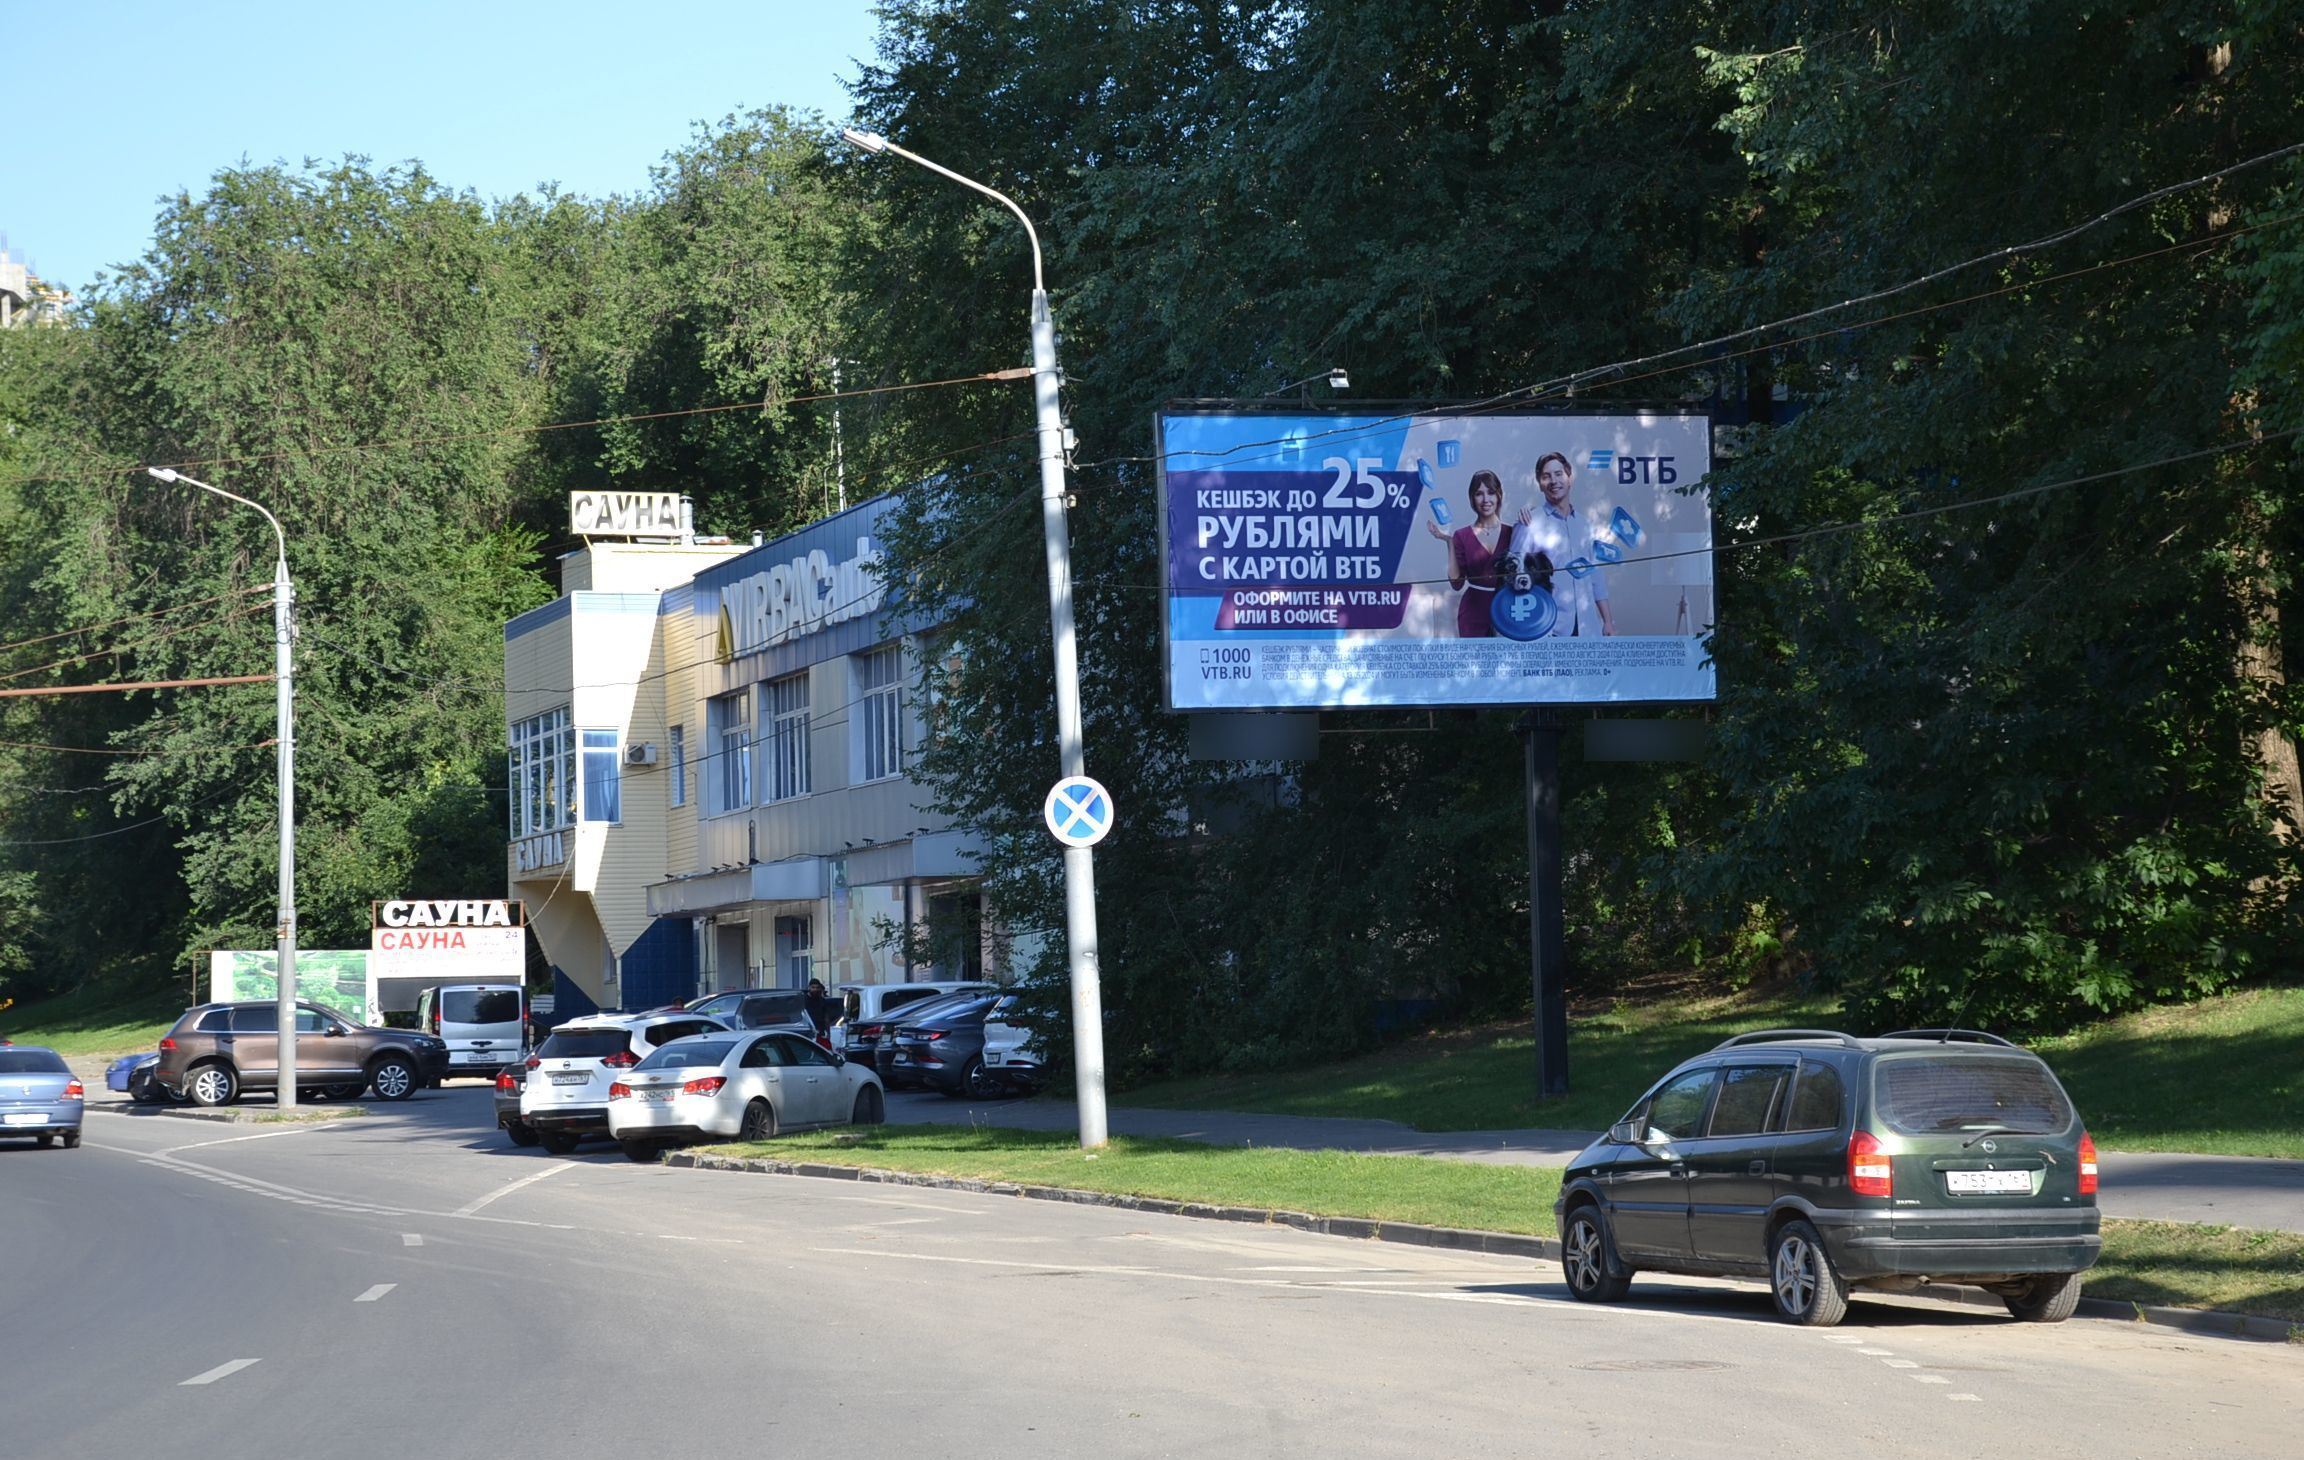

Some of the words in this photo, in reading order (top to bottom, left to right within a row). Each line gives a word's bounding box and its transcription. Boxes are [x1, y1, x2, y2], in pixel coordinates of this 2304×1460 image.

[1617, 456, 1677, 485] ВТБ
[1196, 489, 1282, 509] КЕШБЭК
[1286, 489, 1317, 512] ДО
[1322, 456, 1411, 509] 25%
[574, 494, 677, 530] САУНА
[1197, 515, 1380, 549] РУБЛЯМИ
[1198, 556, 1216, 580] С
[1223, 550, 1328, 580] КАРТОЙ
[1335, 555, 1382, 580] ВТБ
[1233, 591, 1320, 606] ОФОРМИТЕ
[1324, 591, 1345, 605] НА
[1348, 590, 1401, 606] VTB.RU
[1234, 609, 1267, 624] ИЛИ
[1271, 609, 1280, 623] В
[1284, 608, 1338, 624] ОФИСЕ
[1213, 648, 1251, 663] 1000
[1201, 666, 1252, 679] VTB.RU
[1523, 669, 1540, 677] БАНК
[1540, 669, 1553, 677] ВТБ
[382, 900, 512, 928] САУНА
[380, 931, 466, 950] САУНА
